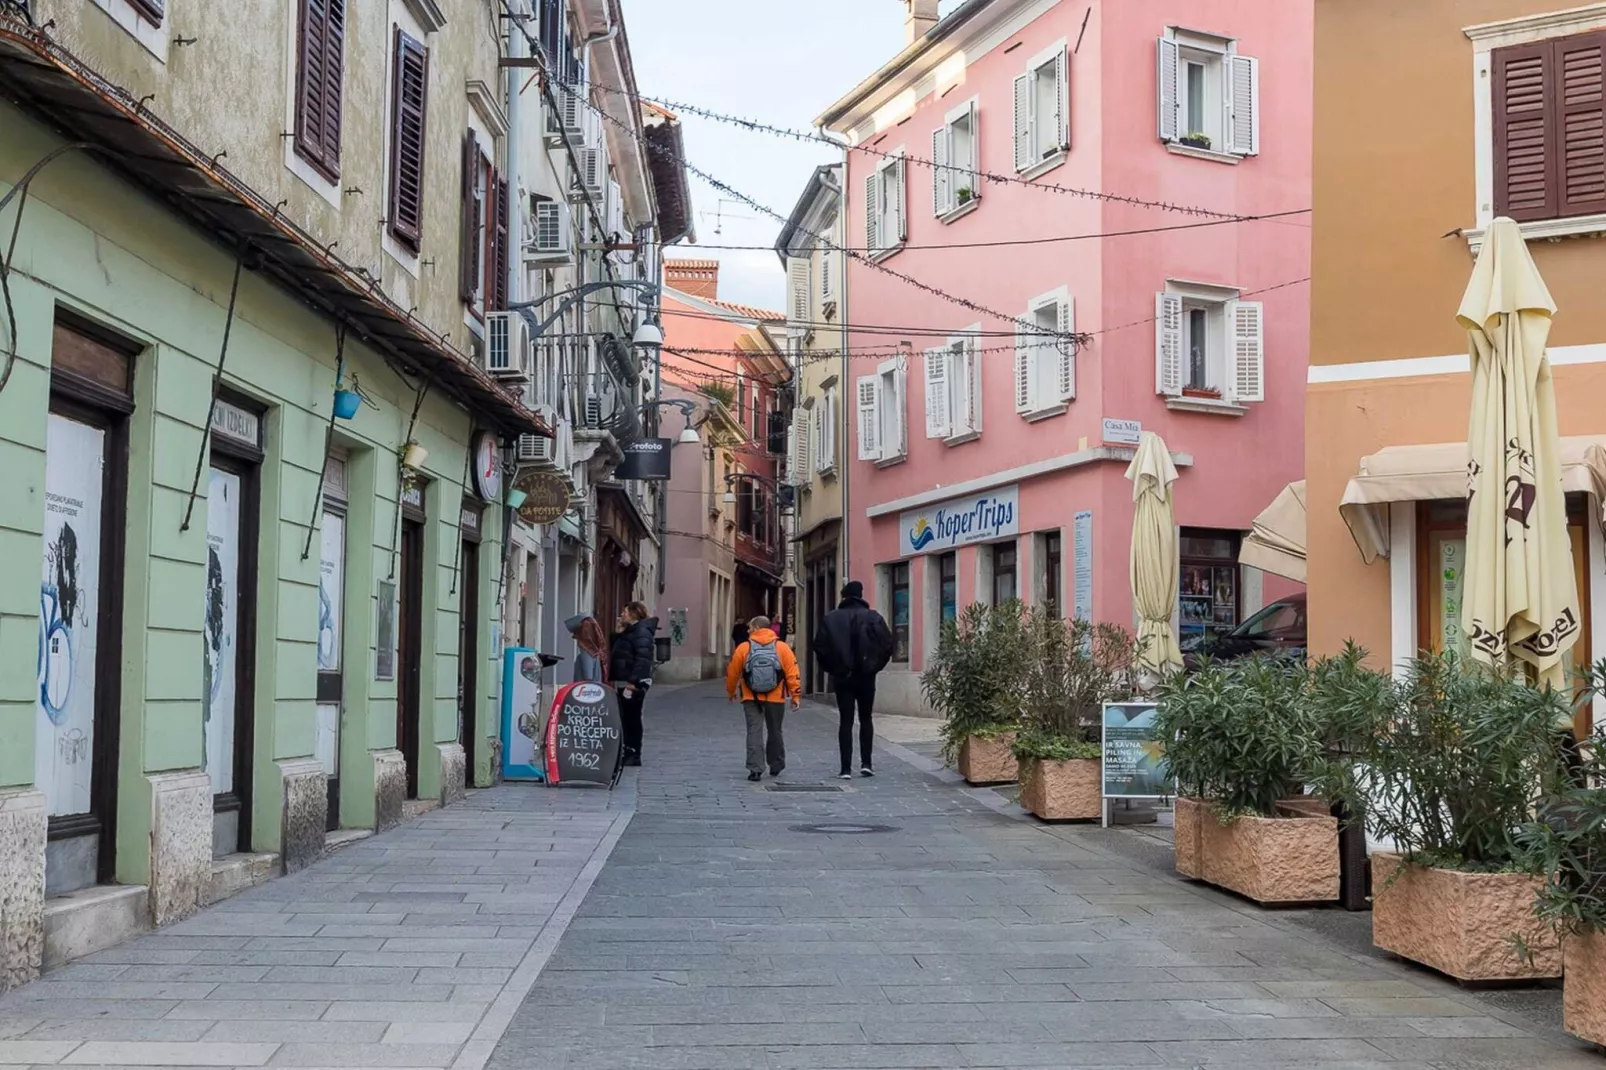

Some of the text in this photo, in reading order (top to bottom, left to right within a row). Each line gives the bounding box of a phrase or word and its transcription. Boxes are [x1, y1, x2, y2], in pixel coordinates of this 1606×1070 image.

[1104, 420, 1139, 431] Casa Mia
[564, 704, 609, 716] DOMAČI
[568, 716, 603, 727] KROFI
[557, 724, 619, 740] PO RECEPTU
[559, 738, 604, 751] IZ LETA
[568, 752, 600, 770] 1962
